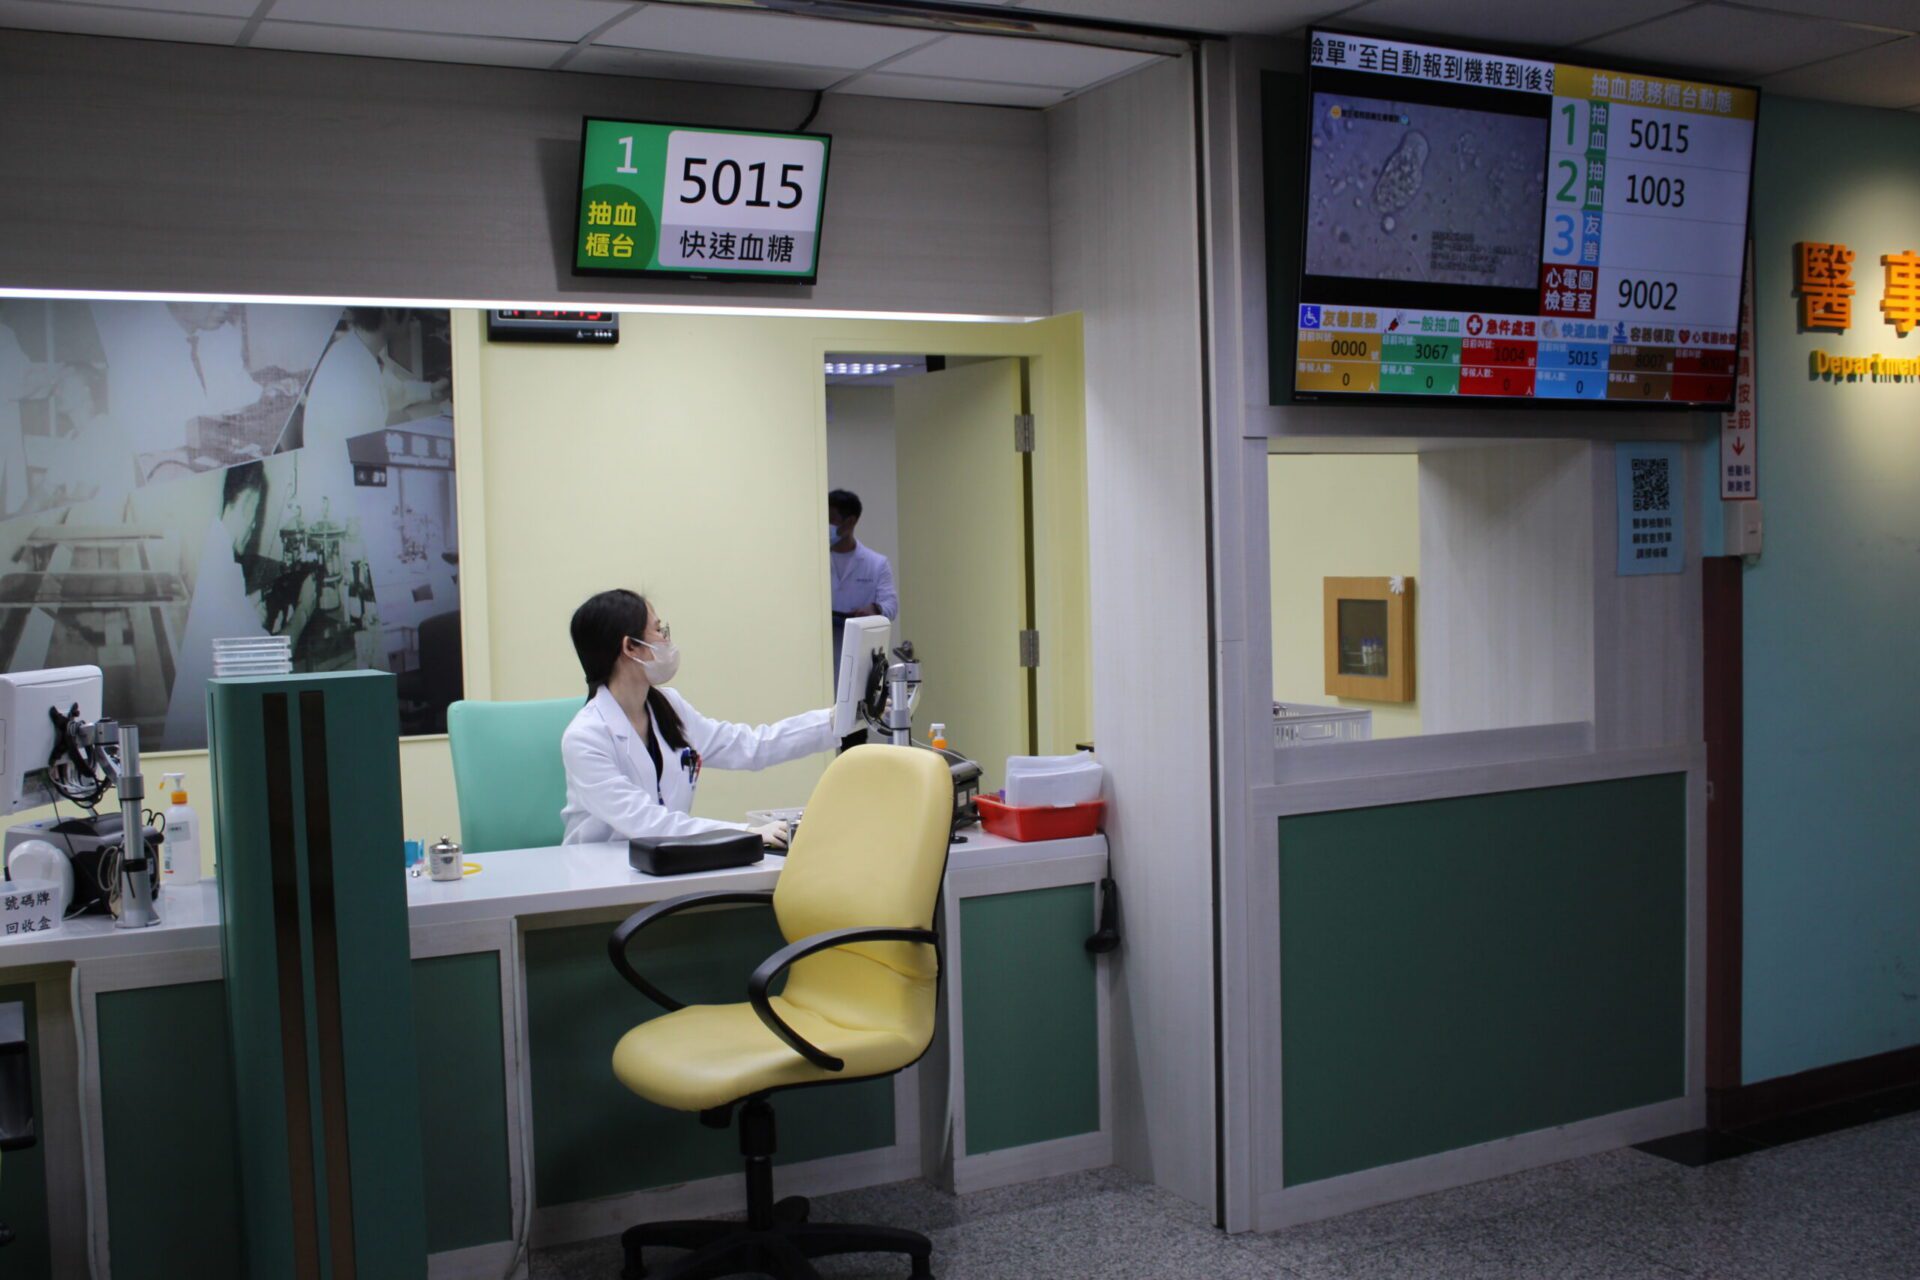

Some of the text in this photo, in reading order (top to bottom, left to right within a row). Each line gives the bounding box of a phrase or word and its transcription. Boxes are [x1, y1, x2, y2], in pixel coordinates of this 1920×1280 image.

[1591, 74, 1732, 112] 抽血服務櫃台動態
[1561, 103, 1690, 153] 1 抽血 5015
[616, 136, 638, 174] 1
[679, 157, 804, 209] 5015
[1556, 160, 1685, 208] 2 抽血 1003
[587, 201, 637, 227] 抽血
[585, 232, 634, 258] 櫃台
[679, 230, 795, 263] 快速血糖
[1552, 214, 1575, 257] 3
[1583, 215, 1600, 262] 友善
[1545, 268, 1678, 311] 心電圖 9002
[1544, 290, 1593, 313] 檢查室
[1323, 309, 1378, 328] 友善服務
[1408, 315, 1460, 333] 一般抽血
[1486, 319, 1536, 336] 急件處理
[1561, 322, 1609, 340] 快速血糖
[1331, 339, 1367, 357] 0000
[1415, 343, 1448, 360] 3067
[1568, 350, 1598, 367] 5015
[1814, 349, 1920, 376] Departmen
[1426, 375, 1433, 389] 0
[1576, 380, 1584, 394] 0
[5, 891, 51, 911] 號碼牌
[5, 915, 52, 935] 回收盒
